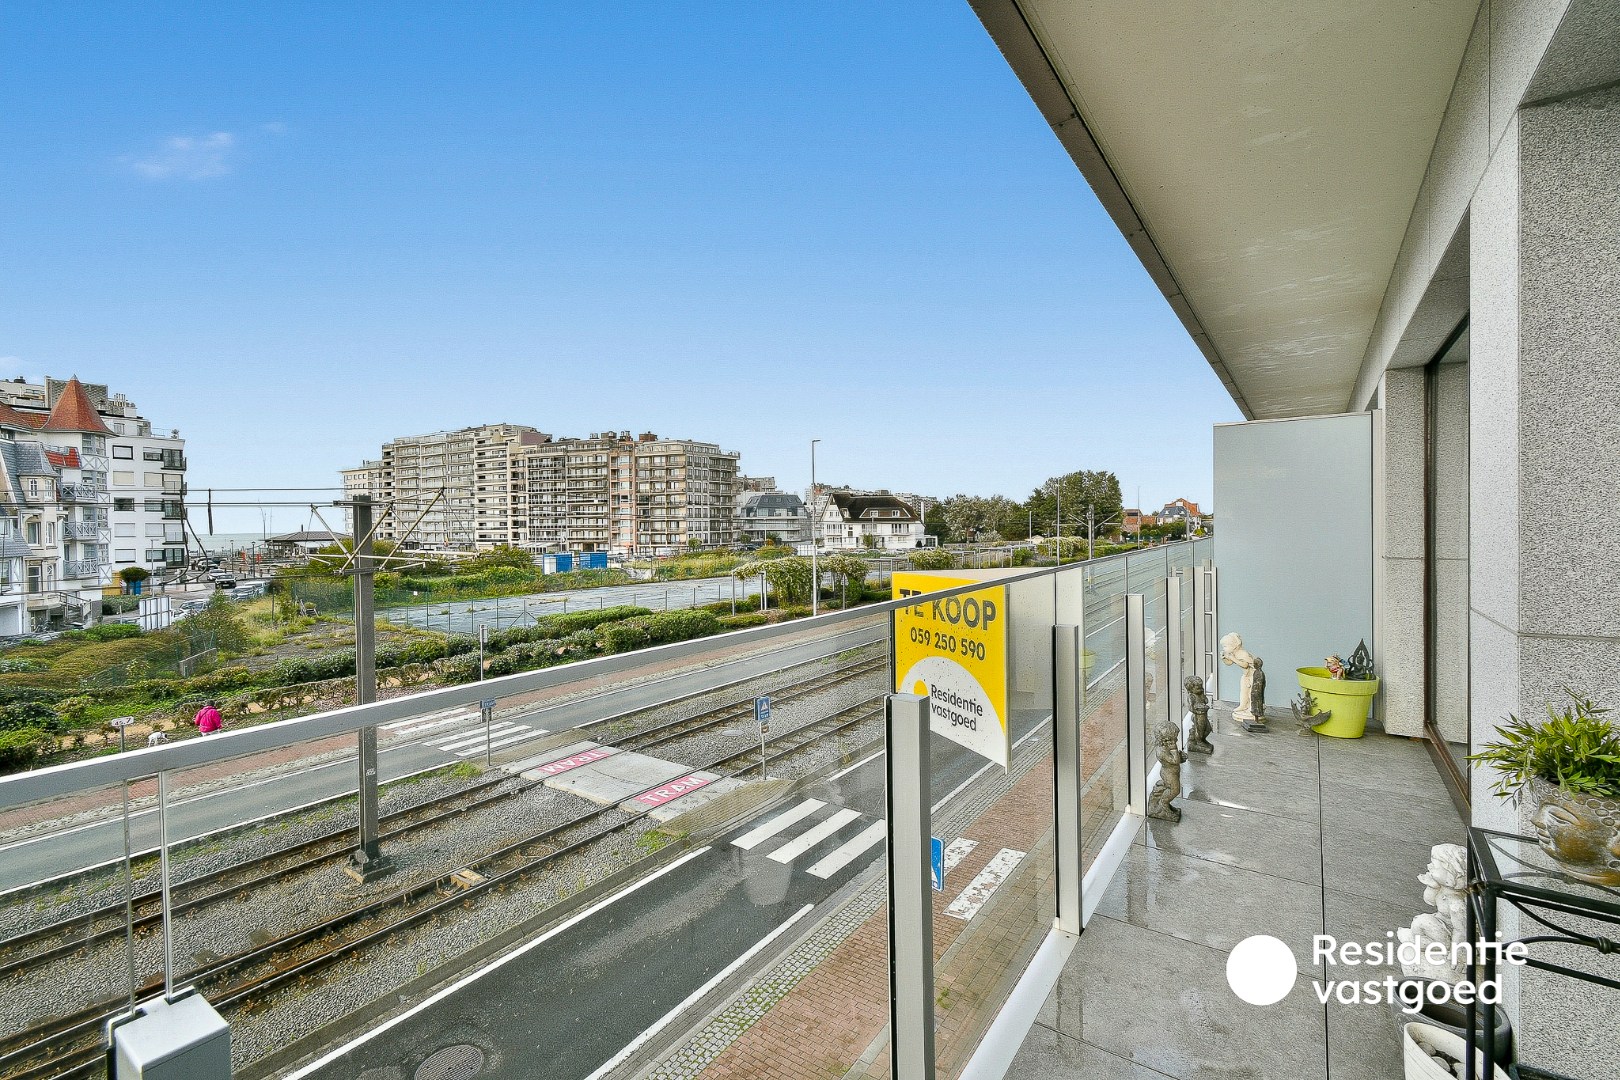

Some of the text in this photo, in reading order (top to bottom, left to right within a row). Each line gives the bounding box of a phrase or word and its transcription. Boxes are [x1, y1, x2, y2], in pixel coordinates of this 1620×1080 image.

[899, 588, 997, 631] TE KOOP
[910, 626, 986, 661] 059 250 590
[930, 684, 983, 717] Residentie
[930, 702, 977, 731] vastgoed
[541, 752, 605, 772] TRAM
[640, 777, 704, 802] TRAM
